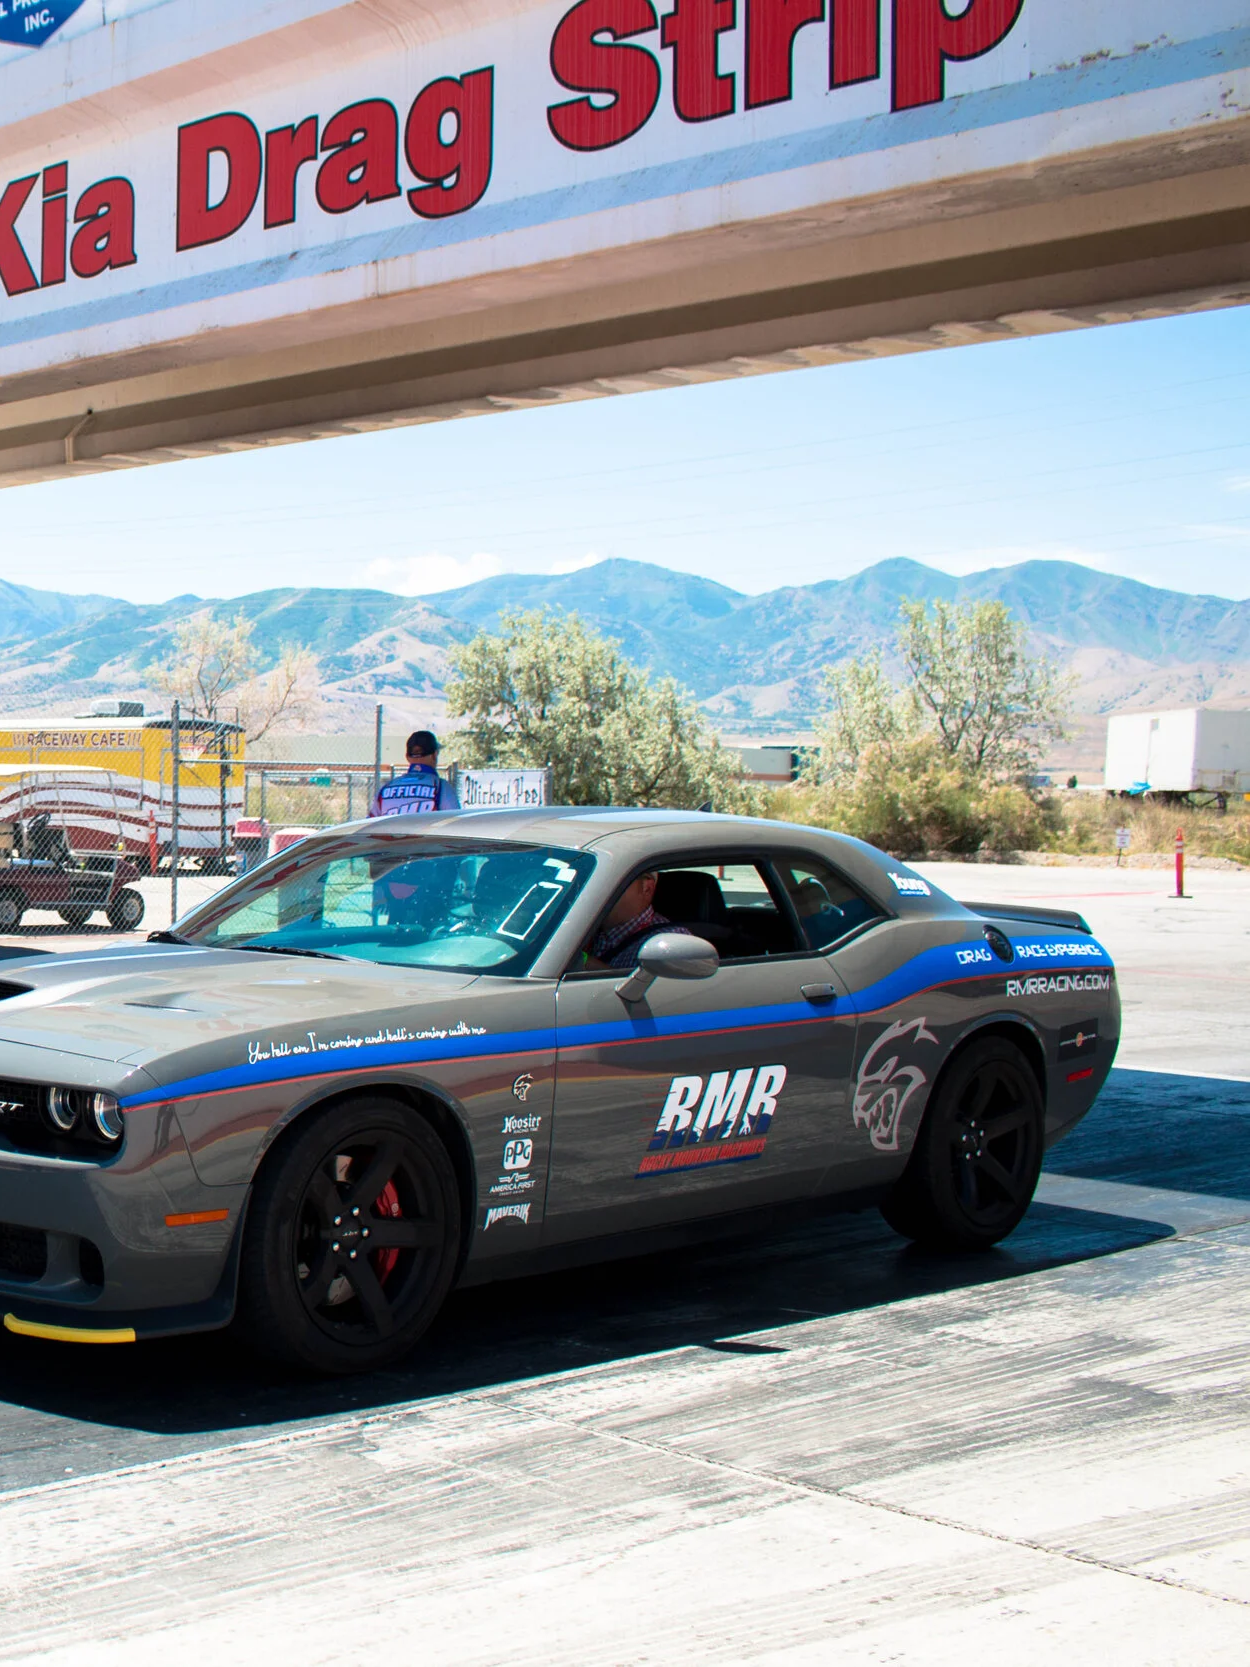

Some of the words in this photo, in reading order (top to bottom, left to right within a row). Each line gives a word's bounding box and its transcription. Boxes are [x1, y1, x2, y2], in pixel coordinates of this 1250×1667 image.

[24, 8, 55, 34] INC.
[175, 64, 496, 252] Drag
[546, 0, 1027, 153] Strip
[90, 731, 126, 747] CAFE
[381, 784, 436, 799] OFFICIAL
[463, 774, 511, 806] Wicked
[886, 871, 932, 897] Young
[955, 948, 992, 965] DRAG
[1015, 944, 1047, 959] RACE
[1005, 974, 1110, 998] RMRRACING.COM
[248, 1041, 270, 1065] You
[270, 1041, 292, 1058] tell
[329, 1034, 364, 1048] coming
[364, 1030, 387, 1044] and
[386, 1027, 416, 1042] hell's
[415, 1026, 448, 1039] coming
[448, 1020, 471, 1036] with
[471, 1027, 487, 1036] me
[647, 1064, 788, 1151] RMR
[501, 1112, 542, 1134] Hoosier
[505, 1140, 532, 1165] PPG
[489, 1182, 518, 1194] AMERICA
[517, 1179, 537, 1189] FIRST
[483, 1202, 532, 1232] MAVERIK
